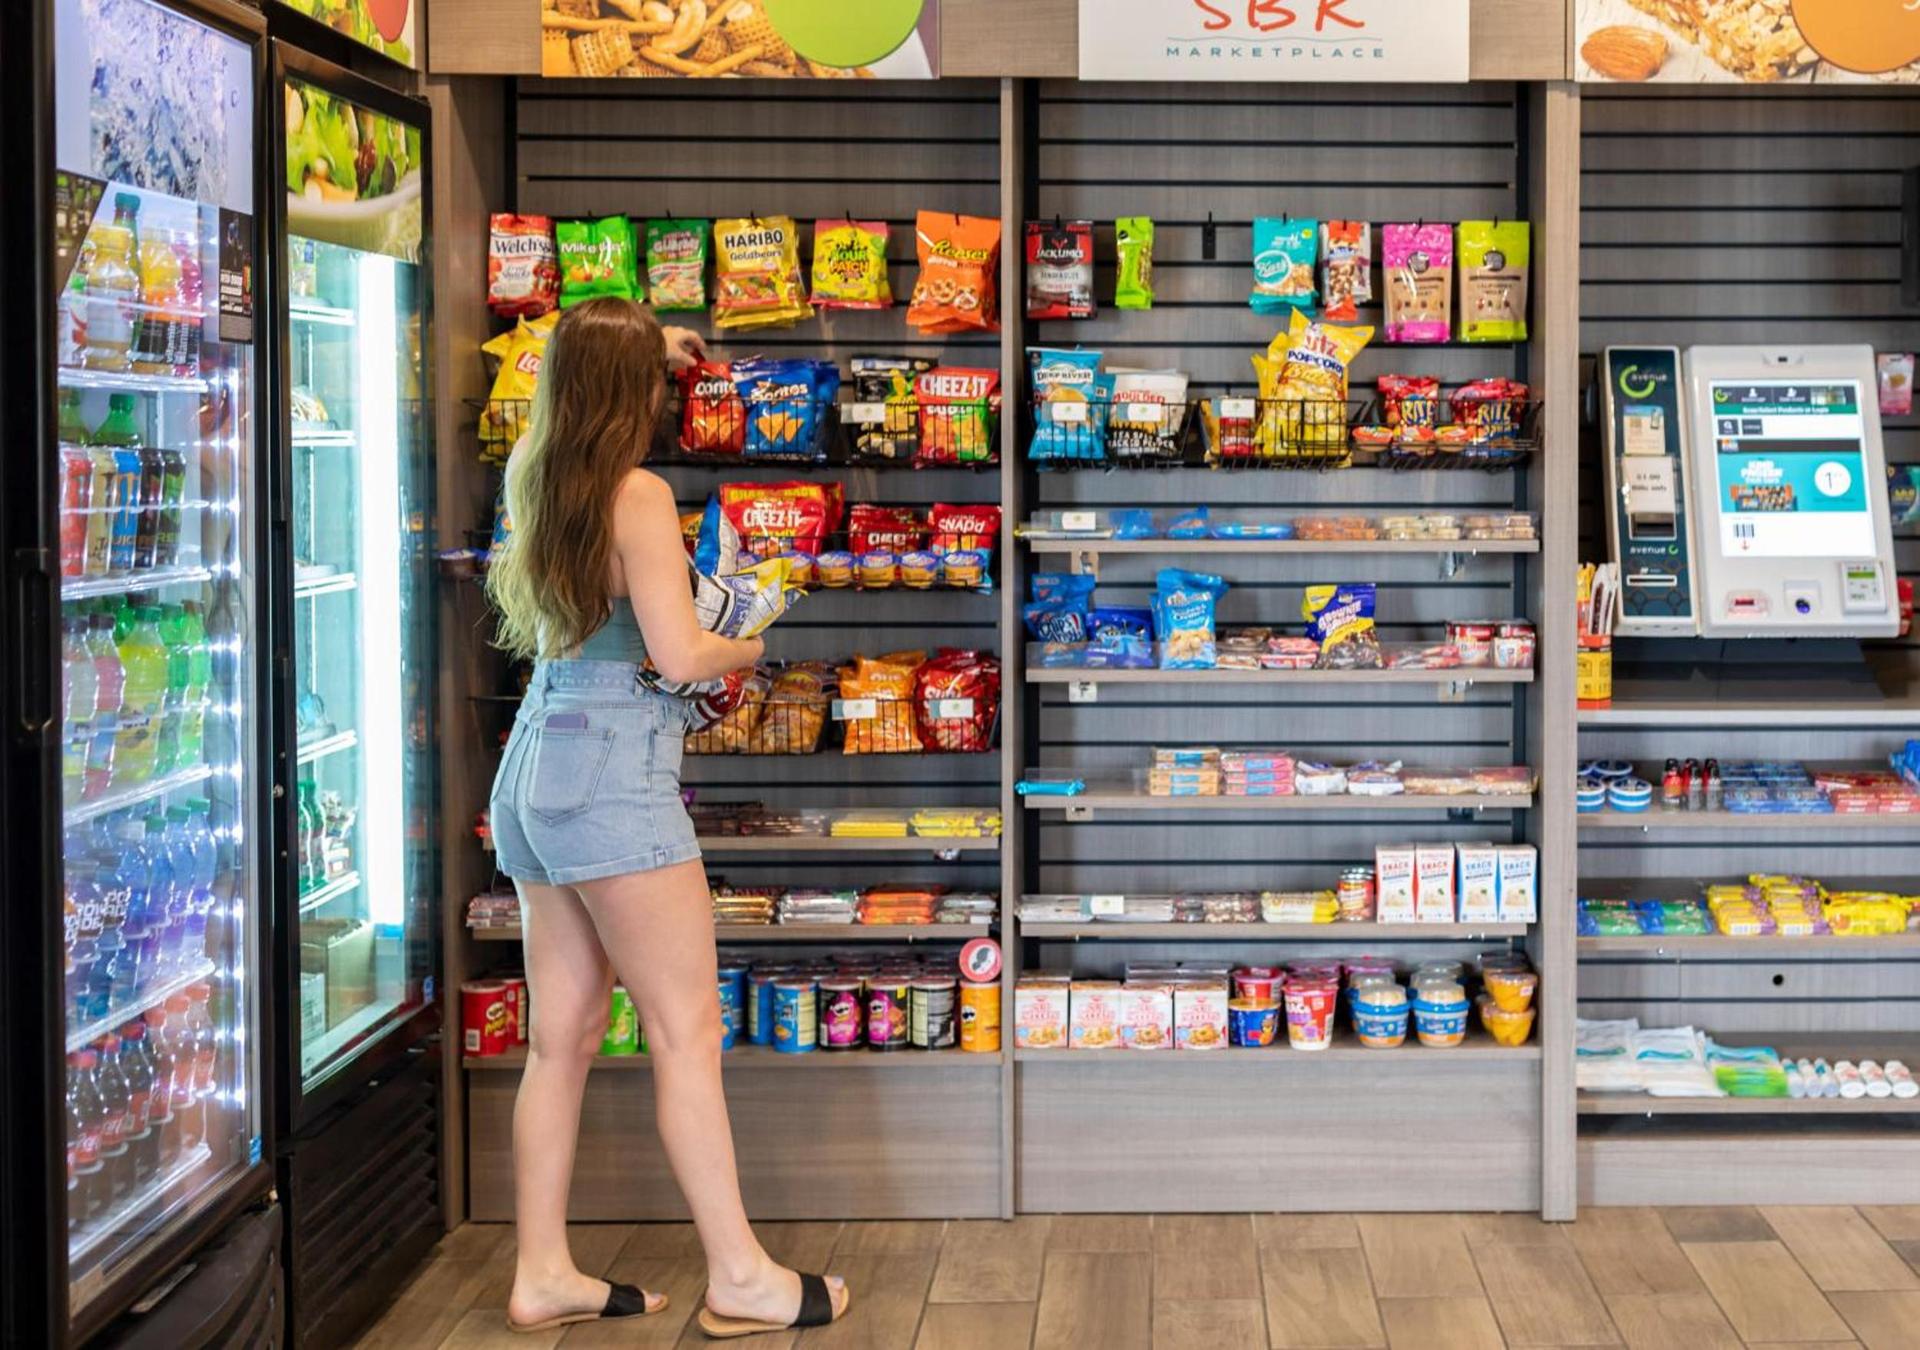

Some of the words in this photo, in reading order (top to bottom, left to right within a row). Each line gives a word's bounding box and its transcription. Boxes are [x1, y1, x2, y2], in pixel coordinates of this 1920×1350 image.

[1166, 47, 1384, 58] MARKETPLACE
[725, 230, 783, 249] HARIBO
[730, 249, 783, 262] Goldbears
